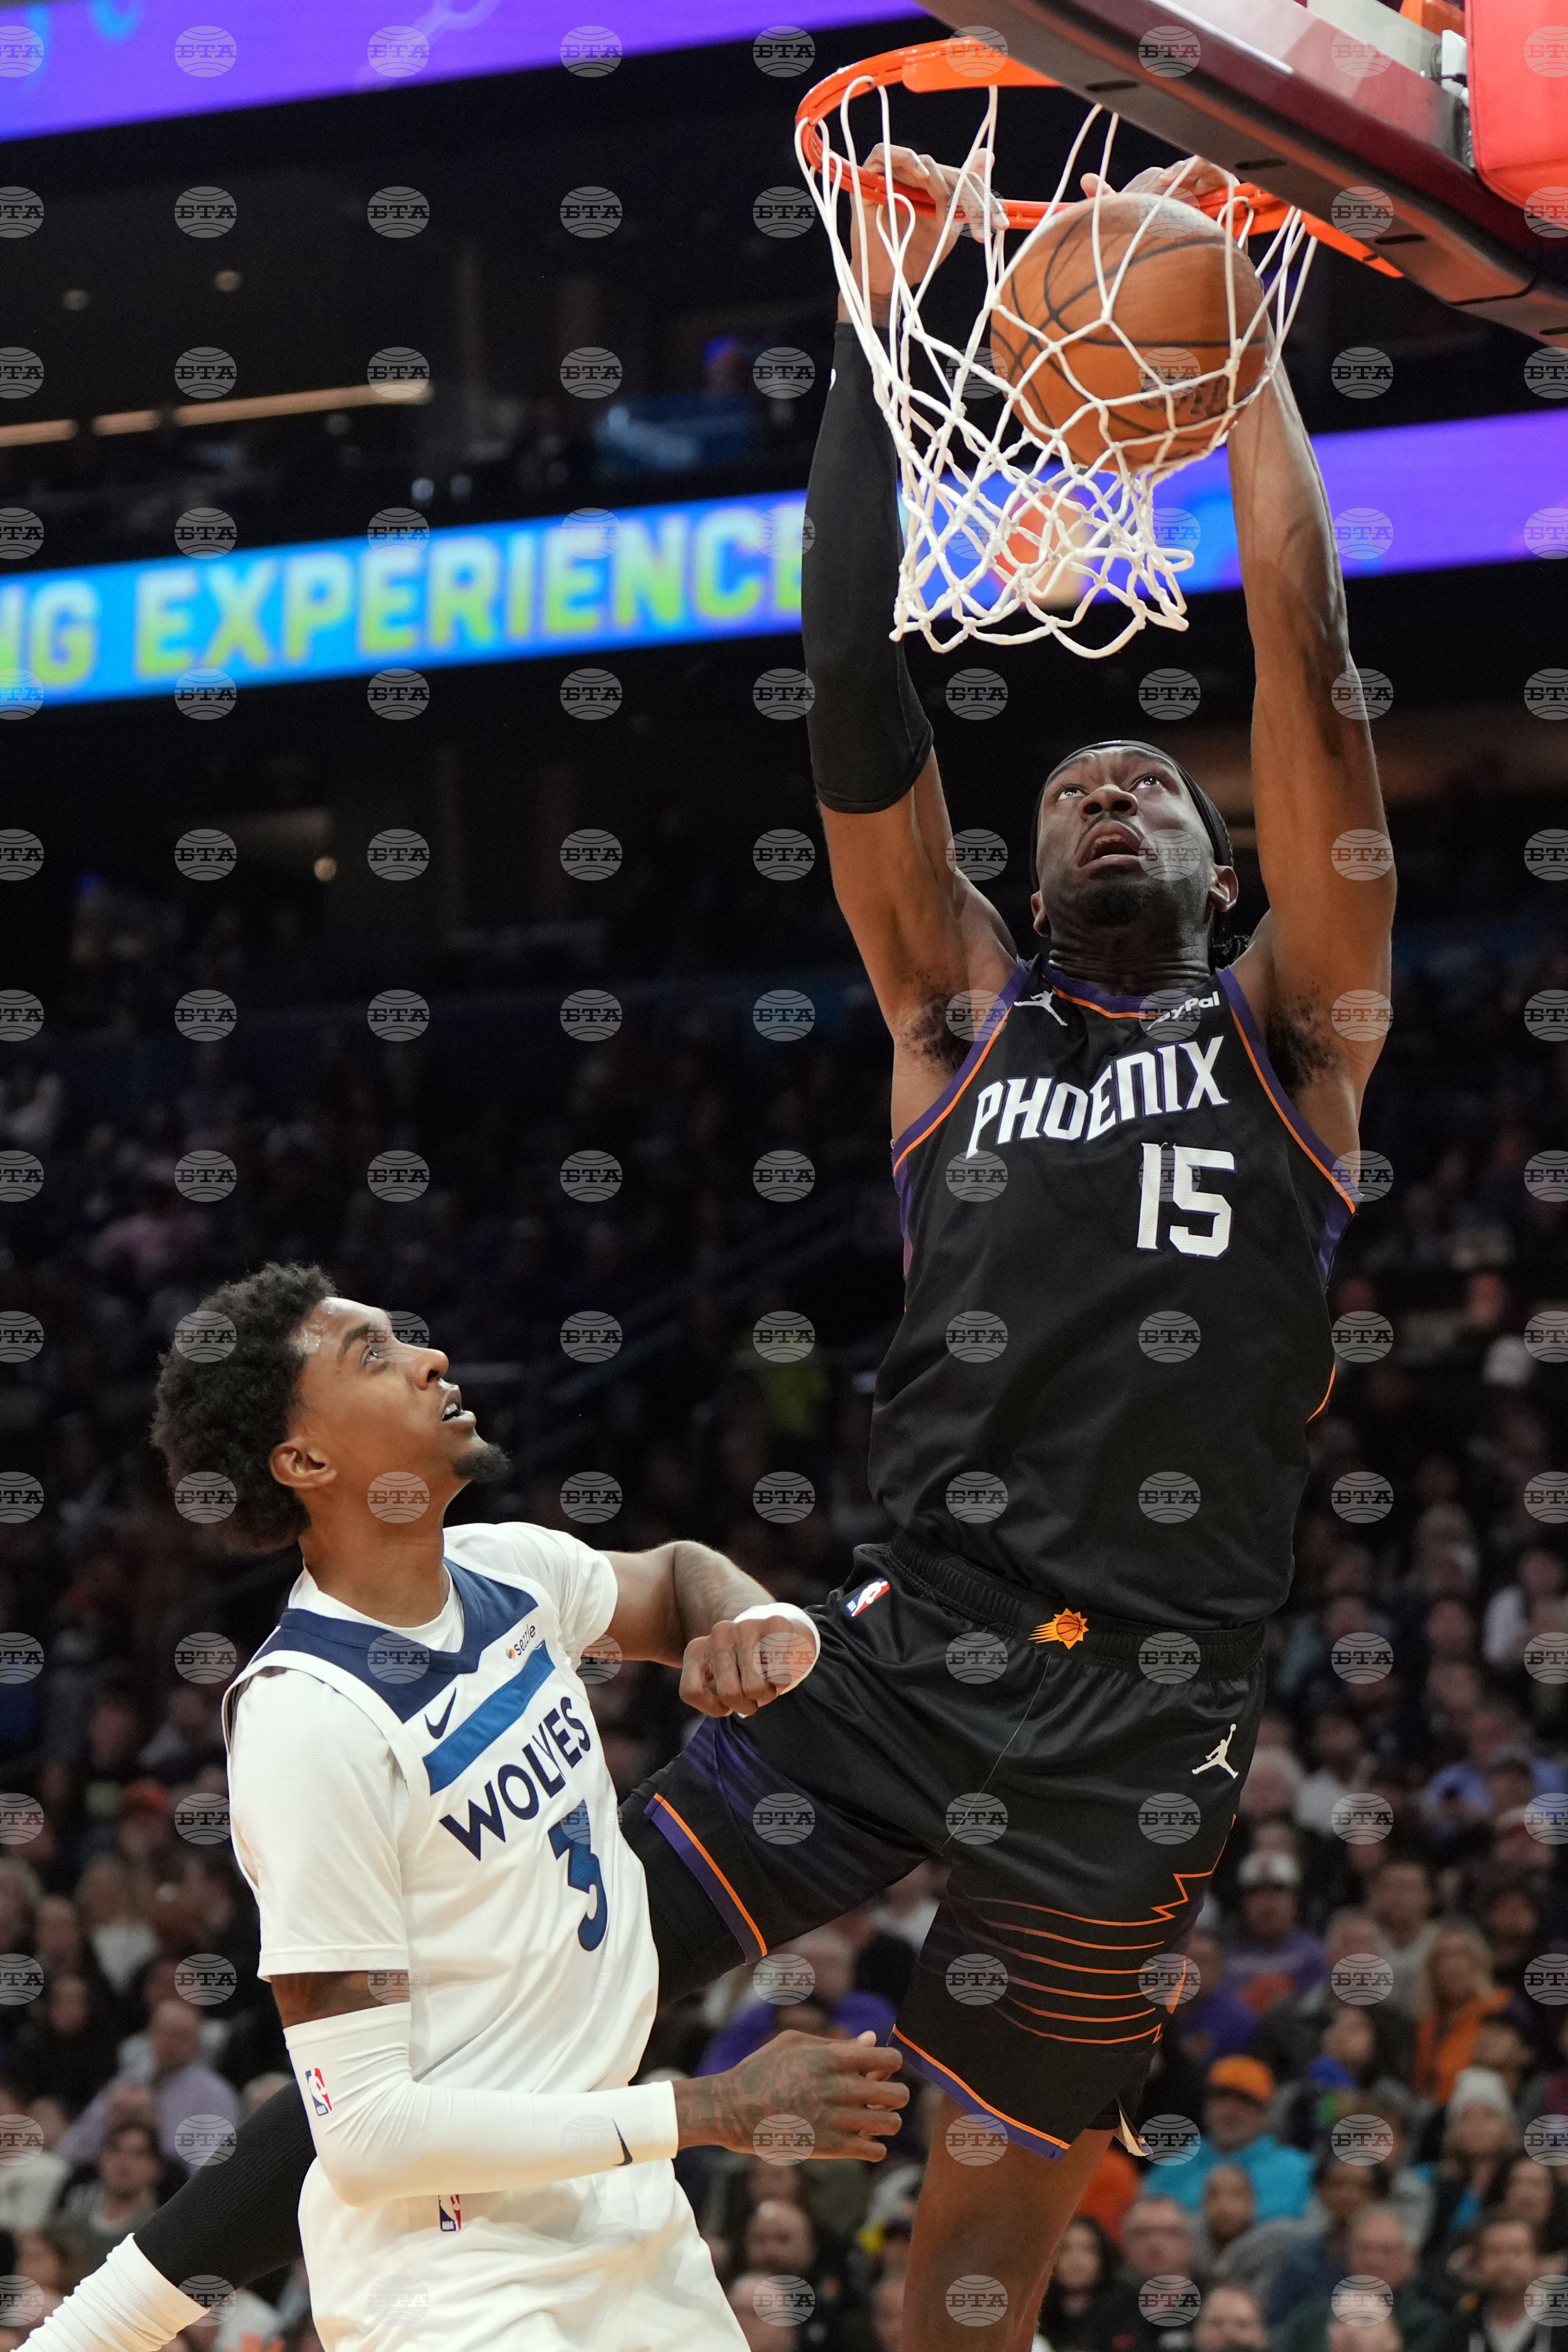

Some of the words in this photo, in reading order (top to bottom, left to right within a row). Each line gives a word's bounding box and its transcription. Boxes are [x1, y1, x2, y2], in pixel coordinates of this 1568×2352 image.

[966, 1035, 1230, 1159] PHOENIX
[1136, 1142, 1236, 1258] 15
[514, 1623, 536, 1656] sezzle
[439, 1697, 591, 1861] WOLVES
[547, 1798, 608, 1951] 3
[442, 2220, 454, 2230] NBA
